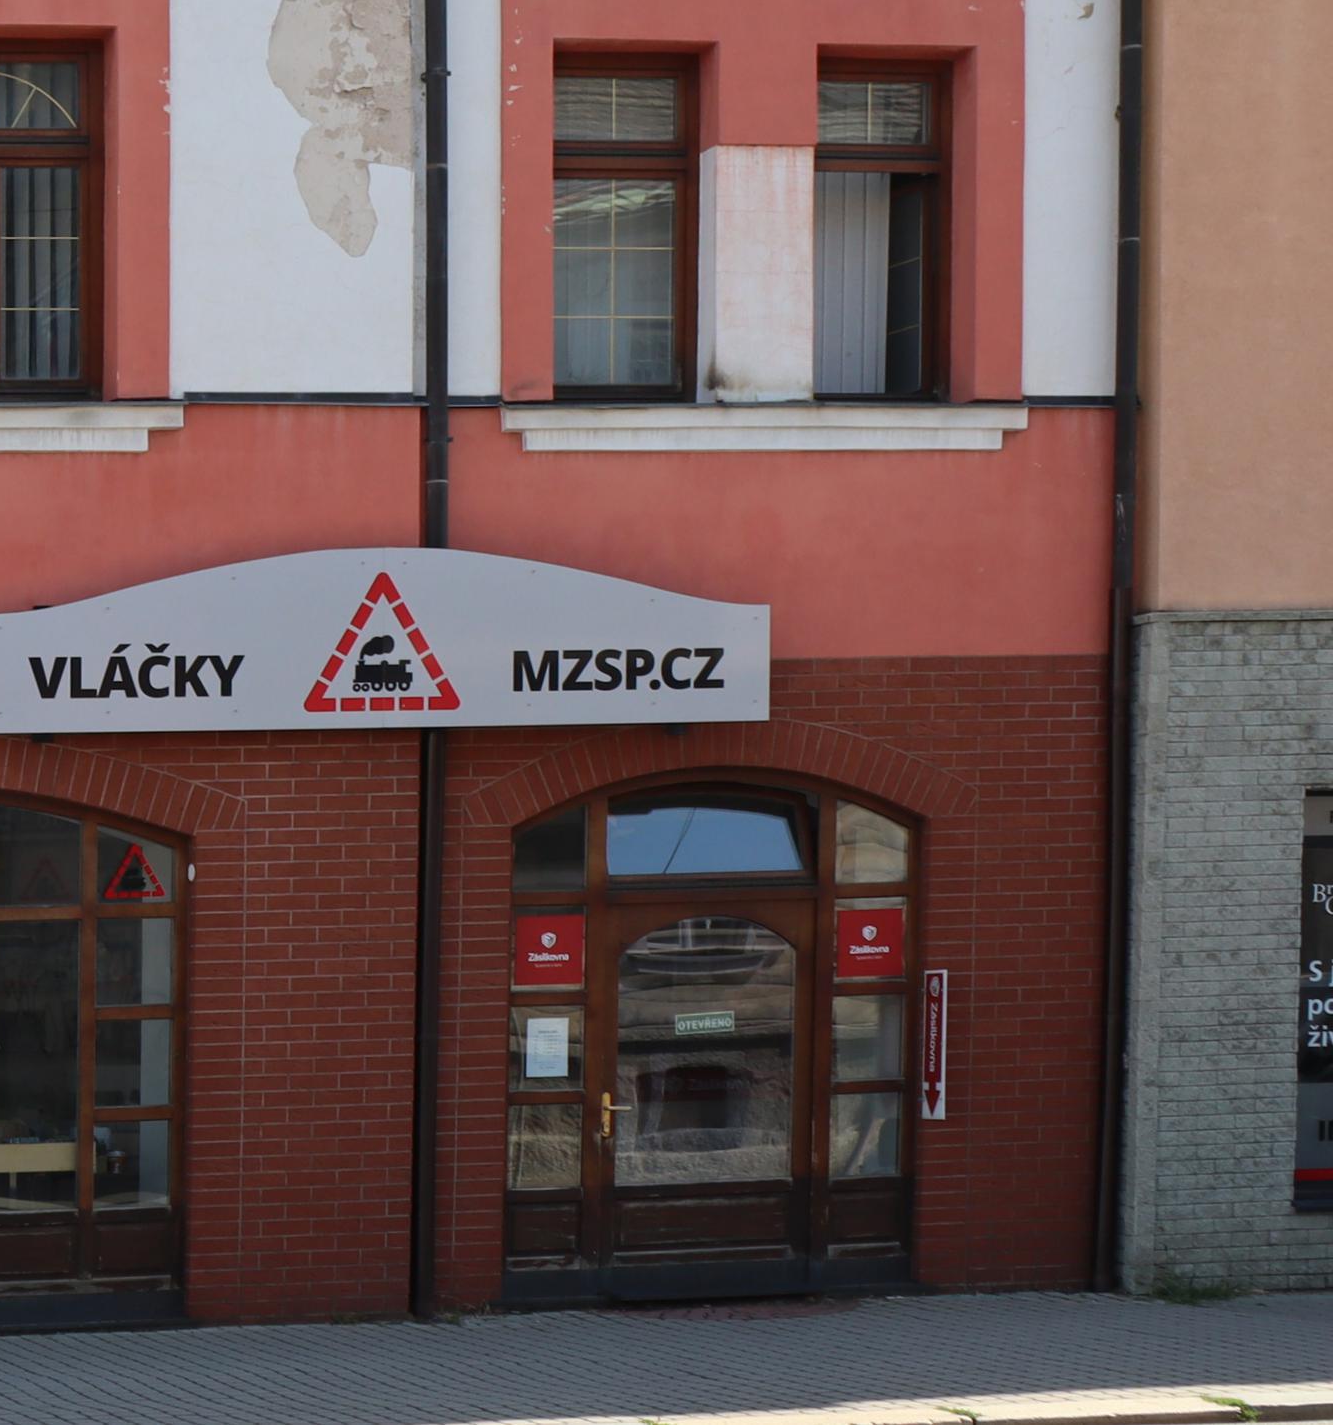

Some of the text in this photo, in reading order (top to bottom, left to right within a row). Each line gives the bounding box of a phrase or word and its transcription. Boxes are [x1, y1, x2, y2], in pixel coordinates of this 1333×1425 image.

[28, 643, 245, 699] VLÁČKY
[513, 647, 725, 692] MZSP.CZ
[1309, 960, 1323, 982] S
[678, 1016, 732, 1031] OTEVŘENO
